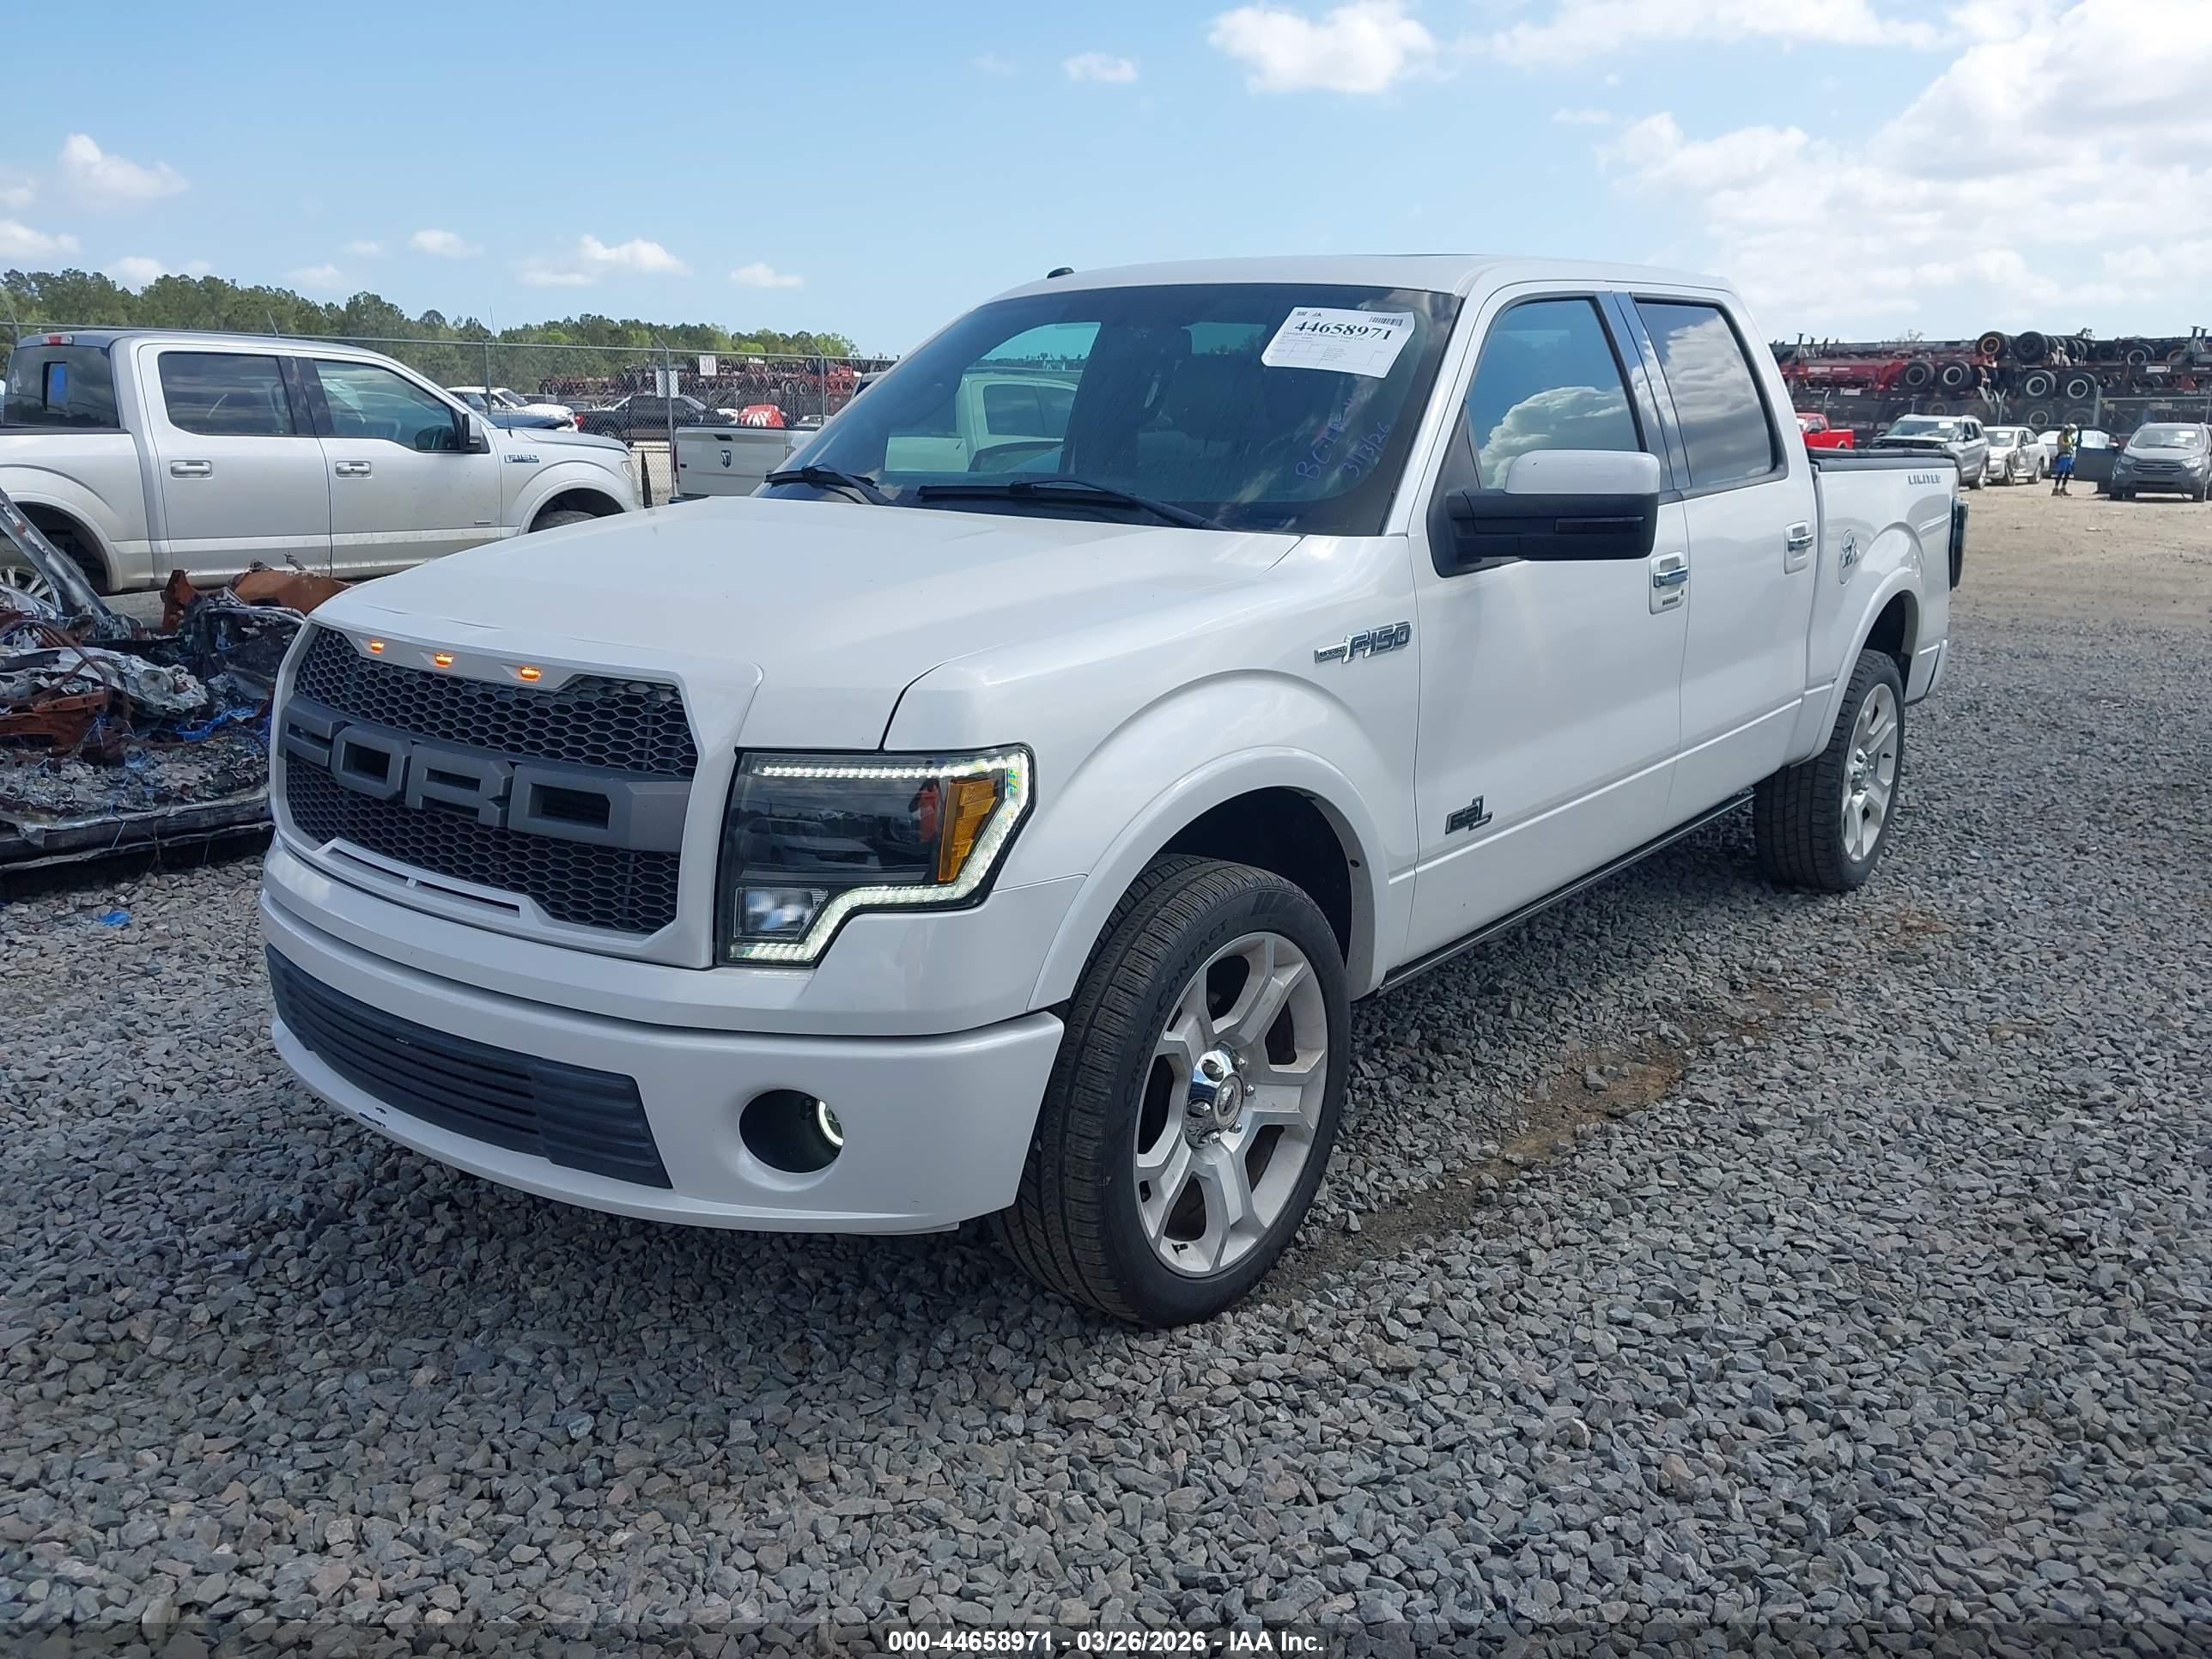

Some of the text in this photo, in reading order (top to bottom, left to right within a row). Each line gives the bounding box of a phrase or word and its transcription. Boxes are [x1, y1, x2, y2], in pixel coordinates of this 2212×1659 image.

[1294, 320, 1393, 341] 44658971
[701, 357, 714, 373] 30
[280, 702, 634, 848] FORD
